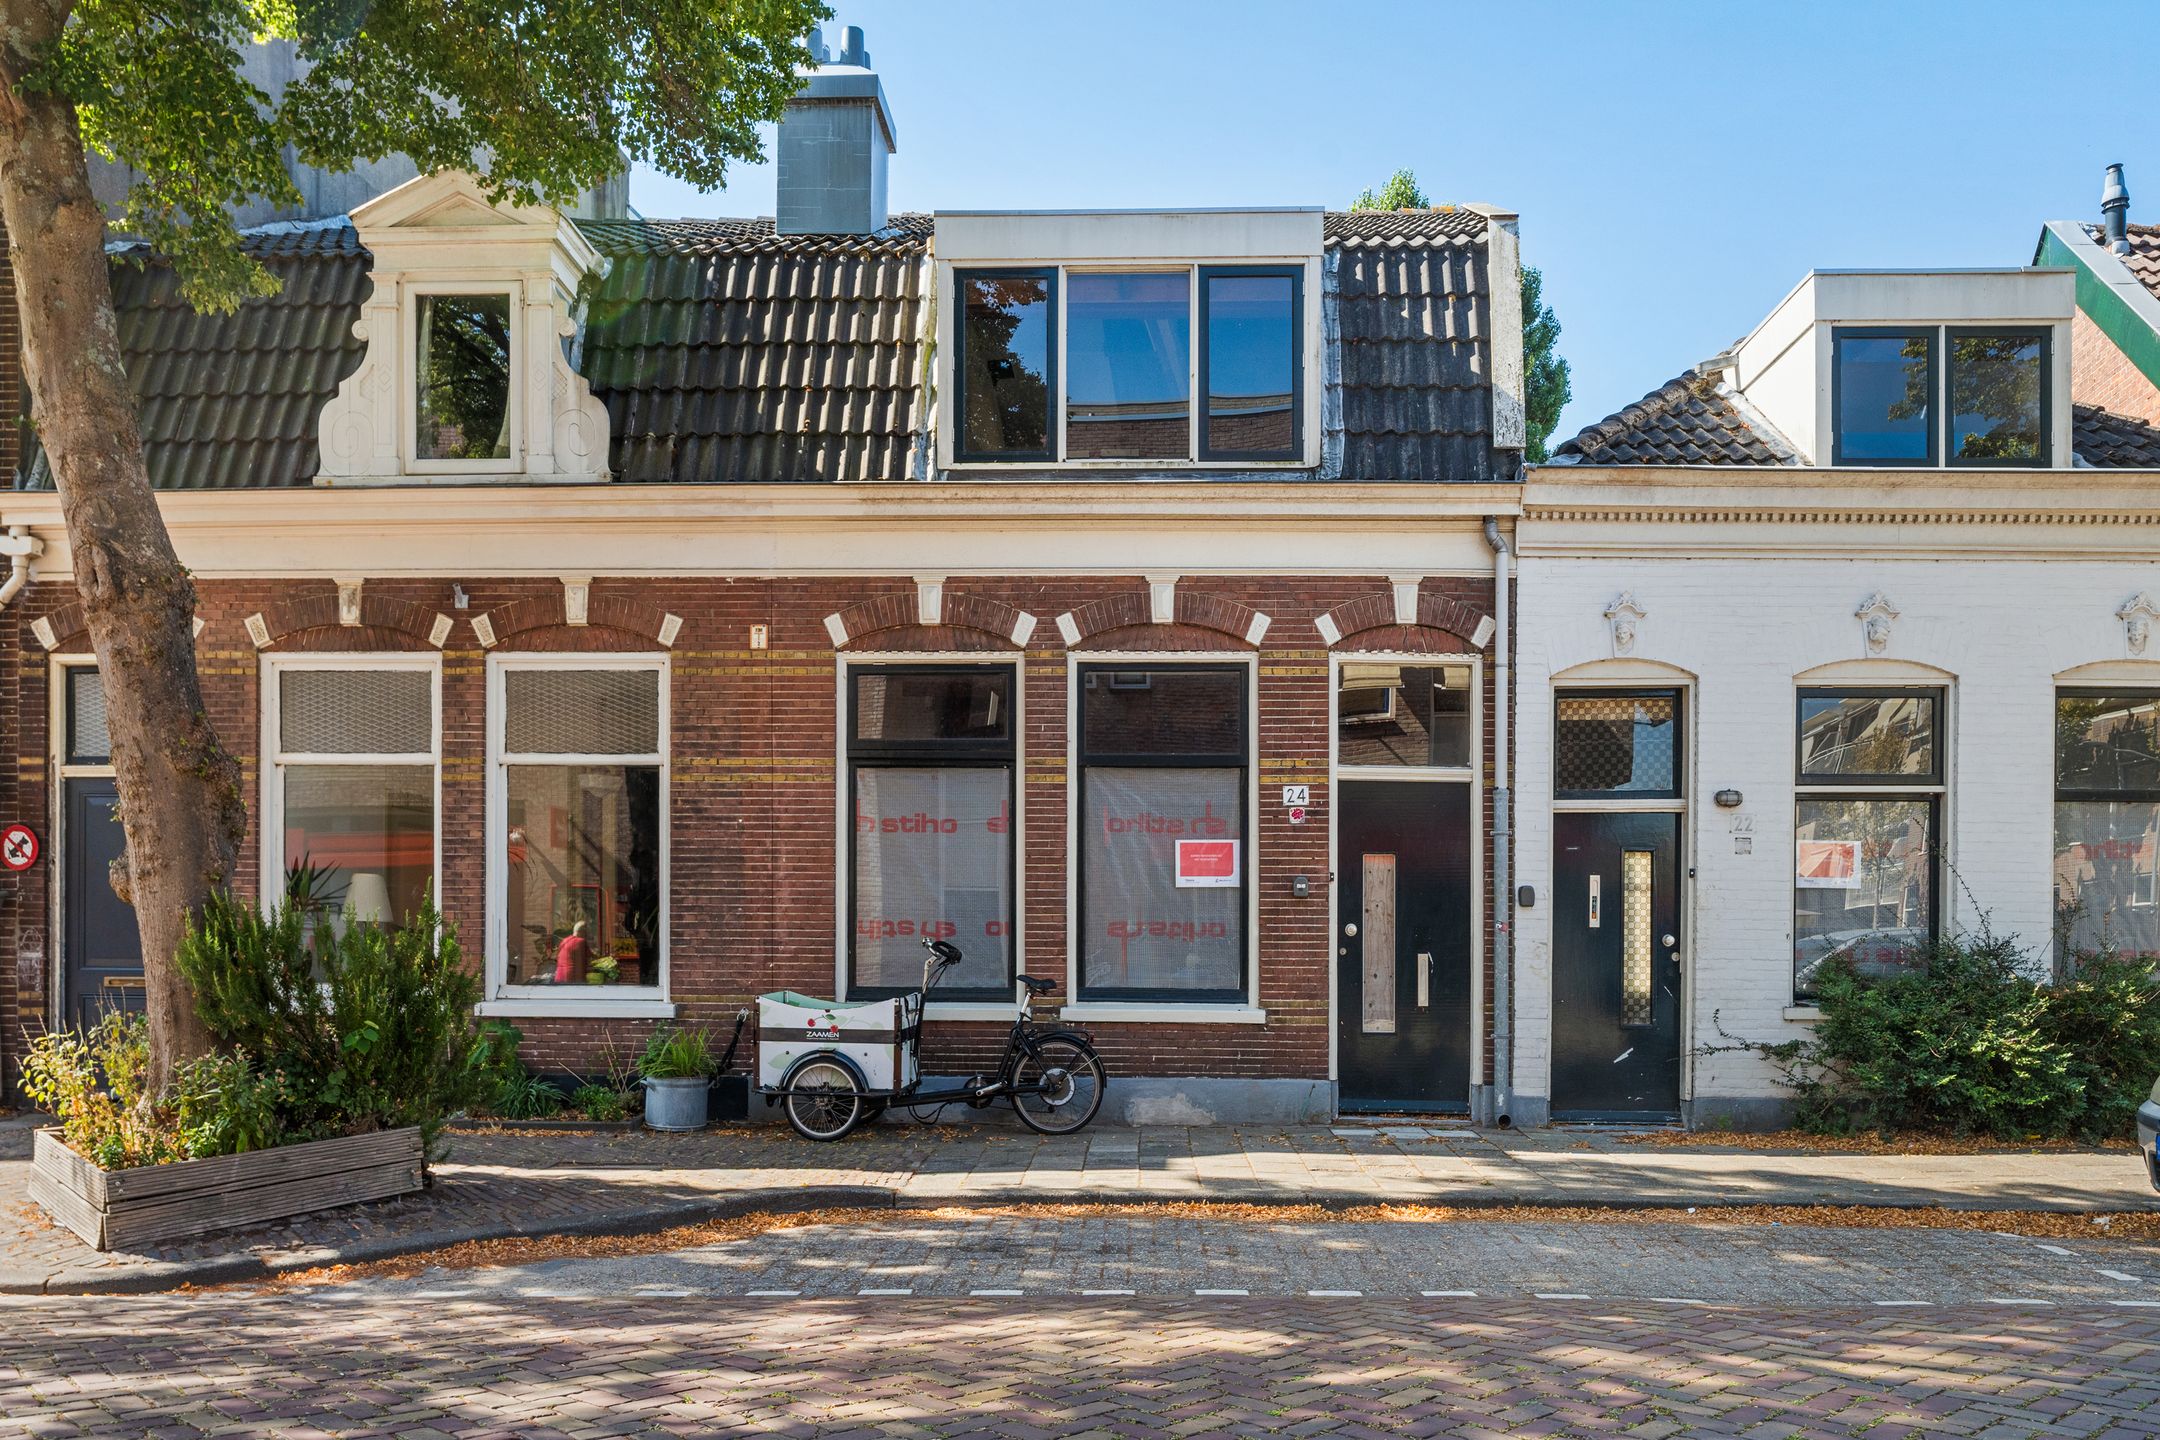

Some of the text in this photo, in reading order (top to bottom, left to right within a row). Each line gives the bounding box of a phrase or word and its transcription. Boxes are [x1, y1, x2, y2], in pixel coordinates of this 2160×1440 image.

[1286, 788, 1306, 803] 24
[881, 812, 958, 834] stiho
[1734, 815, 1754, 832] 22
[806, 1030, 840, 1038] ZAAMEN
